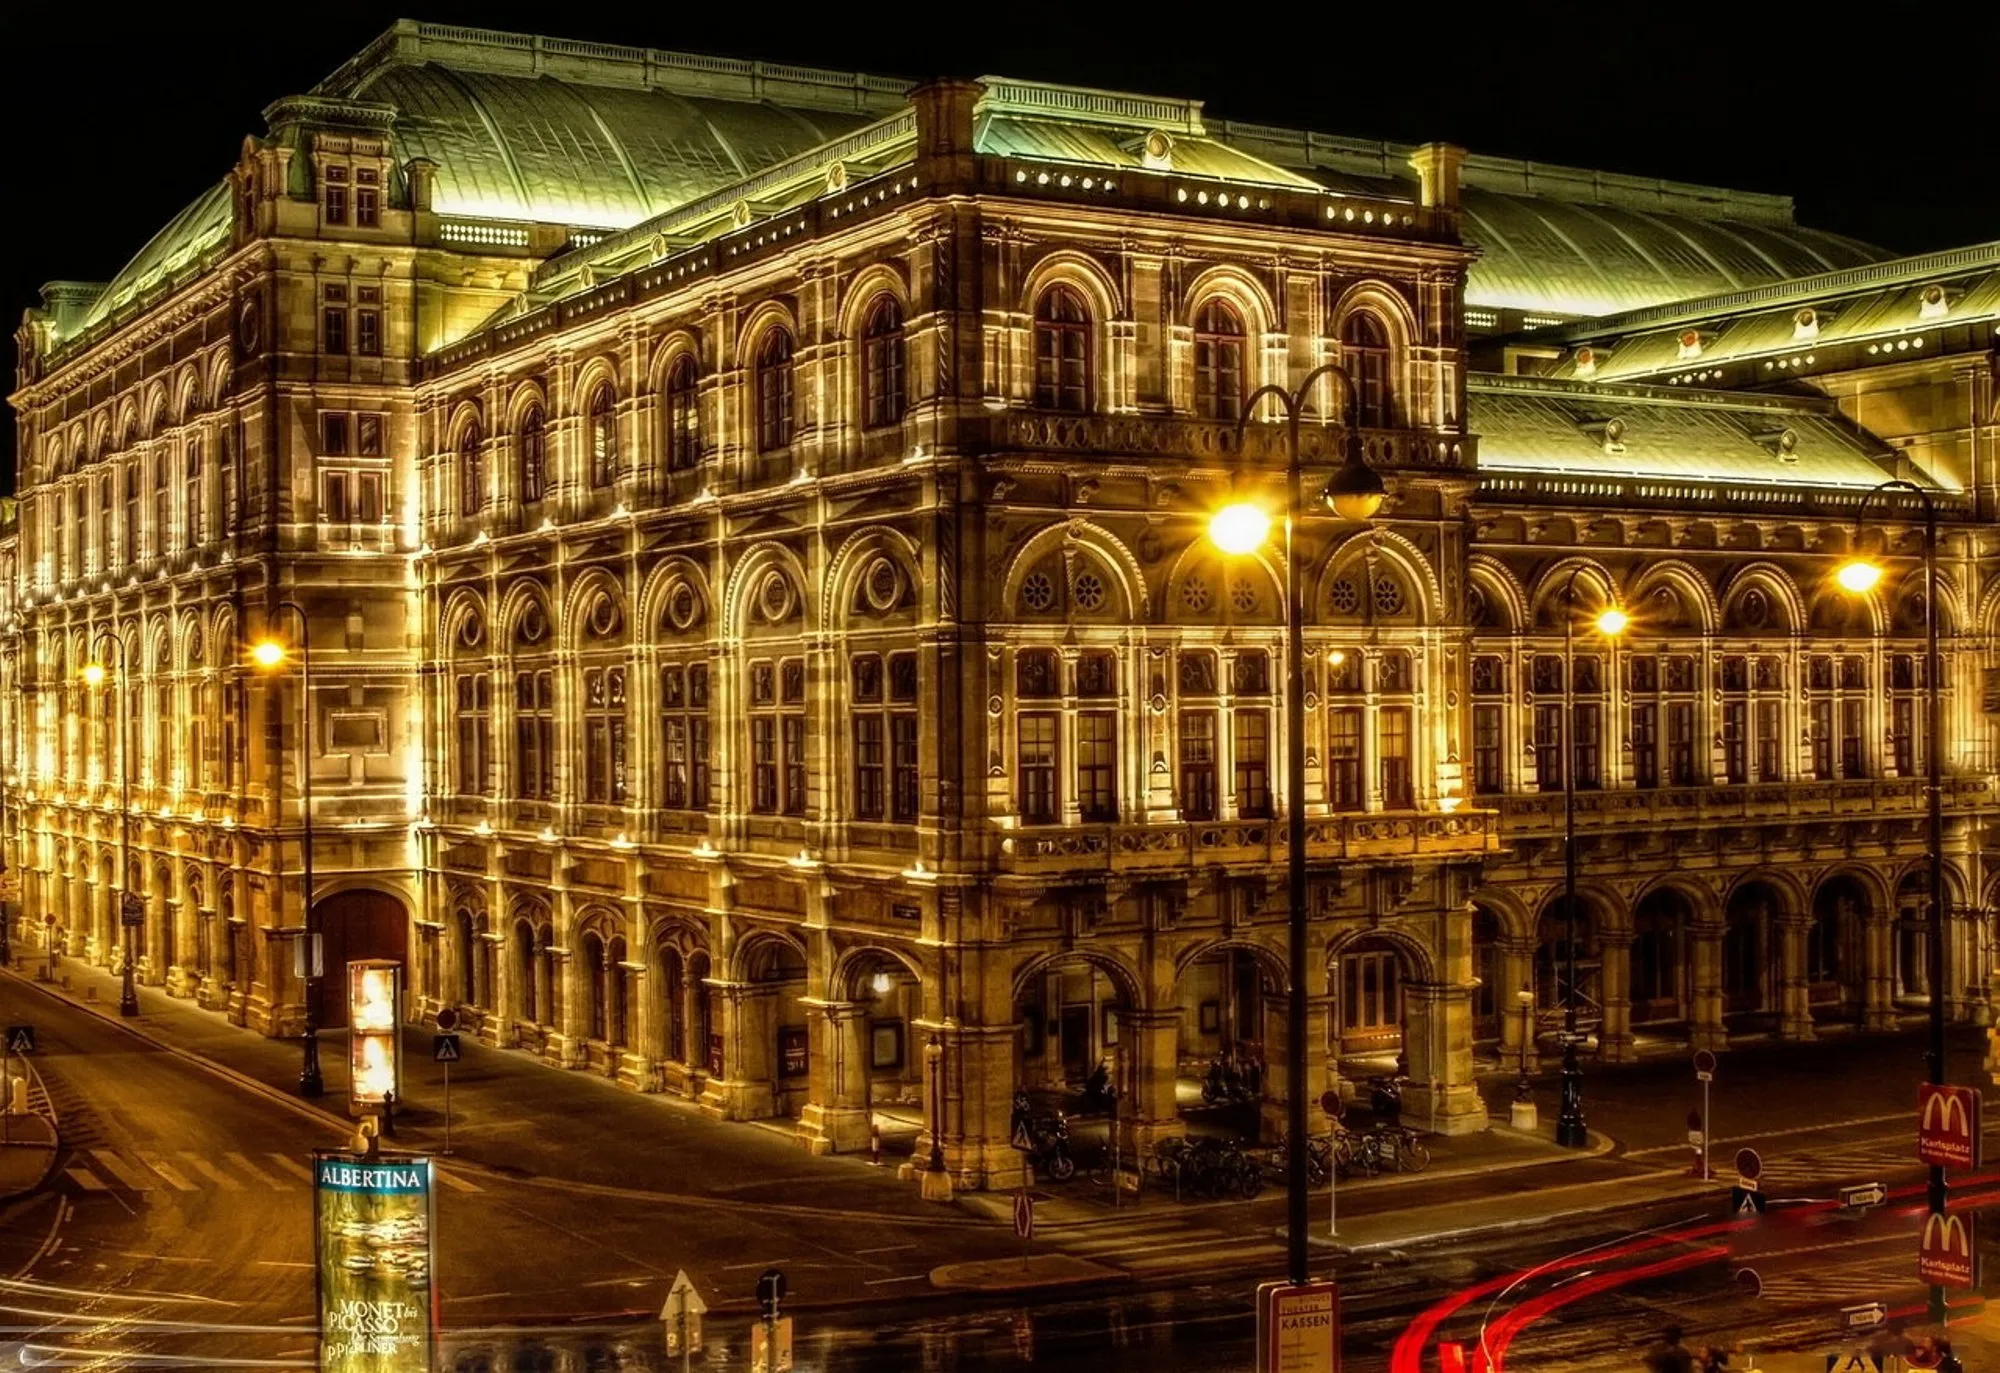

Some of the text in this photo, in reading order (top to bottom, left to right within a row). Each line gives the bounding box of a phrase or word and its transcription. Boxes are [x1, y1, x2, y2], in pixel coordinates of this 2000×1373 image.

[321, 1166, 421, 1188] ALBERTINA
[340, 1299, 405, 1319] MONET
[329, 1311, 399, 1335] PICASSO
[1281, 1315, 1330, 1330] KASSEN
